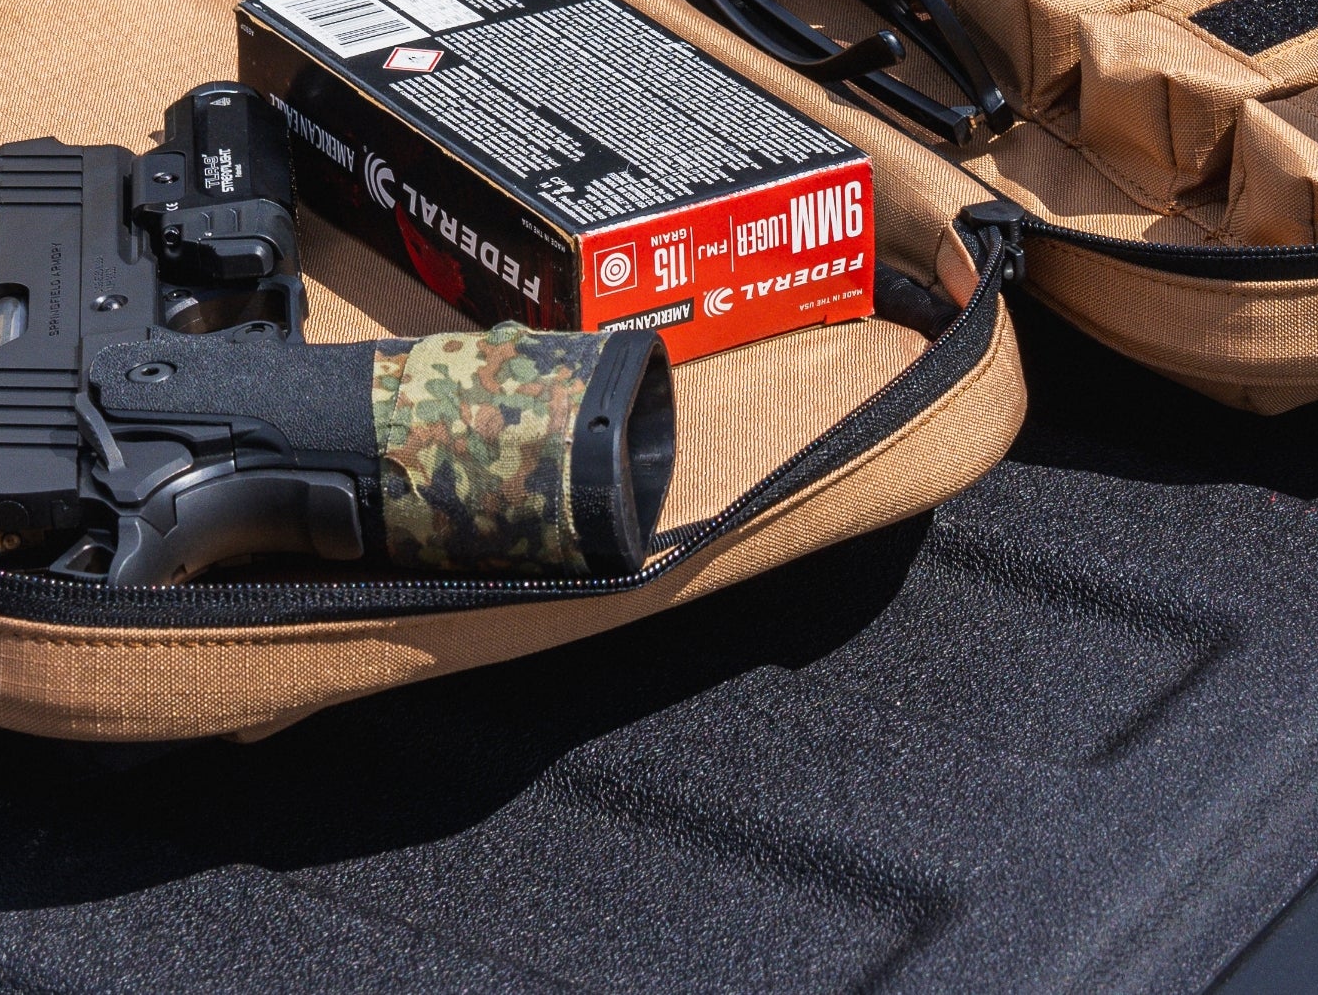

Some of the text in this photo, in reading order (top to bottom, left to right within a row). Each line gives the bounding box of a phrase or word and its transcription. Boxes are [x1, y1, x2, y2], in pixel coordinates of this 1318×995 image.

[300, 114, 355, 173] AMERICAN
[521, 217, 532, 230] USA
[533, 225, 543, 238] THE
[736, 180, 864, 257] 9MM LUGER
[402, 182, 541, 305] FEDERAL
[650, 228, 688, 248] GRAIN
[697, 238, 728, 261] FMJ
[653, 242, 688, 293] 115
[740, 252, 865, 301] FEDERAL
[49, 242, 63, 337] SPRINGFIELD ARMORY
[799, 288, 863, 311] MADE IN THE USA
[636, 303, 691, 330] AMERICAN
